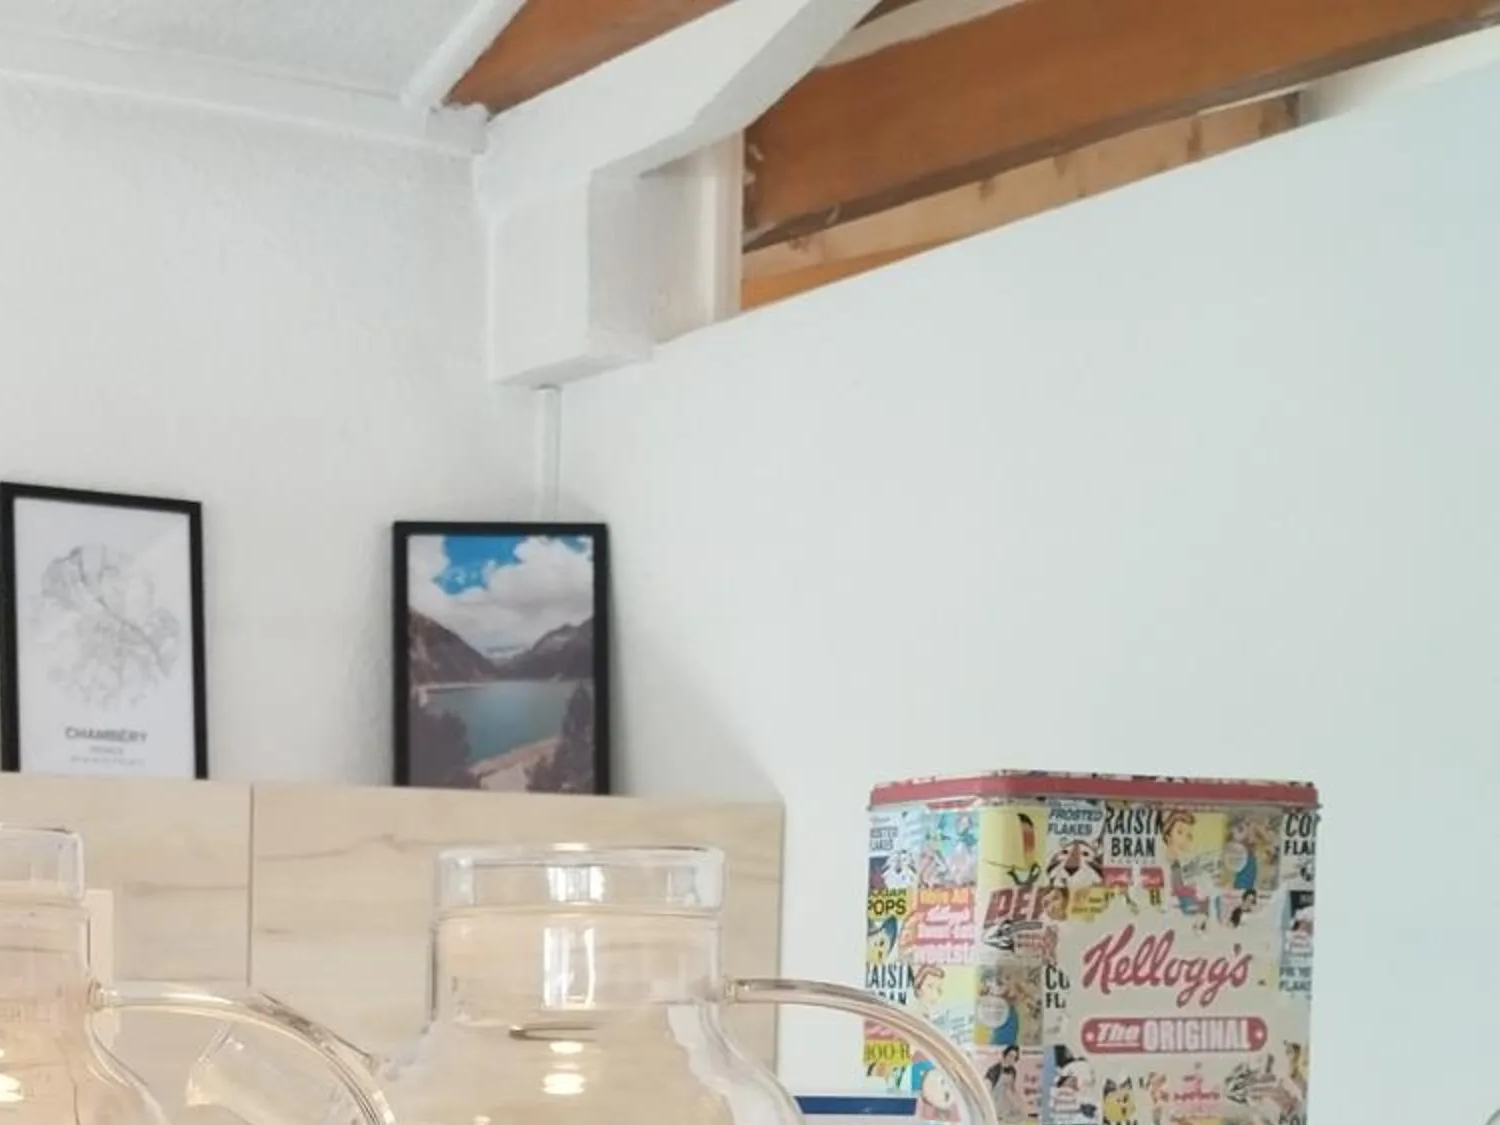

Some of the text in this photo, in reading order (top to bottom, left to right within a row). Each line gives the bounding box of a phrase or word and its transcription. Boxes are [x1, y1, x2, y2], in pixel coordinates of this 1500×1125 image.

[1048, 823, 1092, 836] FLAKES
[1103, 807, 1163, 835] RAISIN
[1111, 838, 1156, 857] BRAN
[1082, 924, 1252, 1007] Kellogg's
[1096, 1019, 1252, 1051] The ORIGINAL
